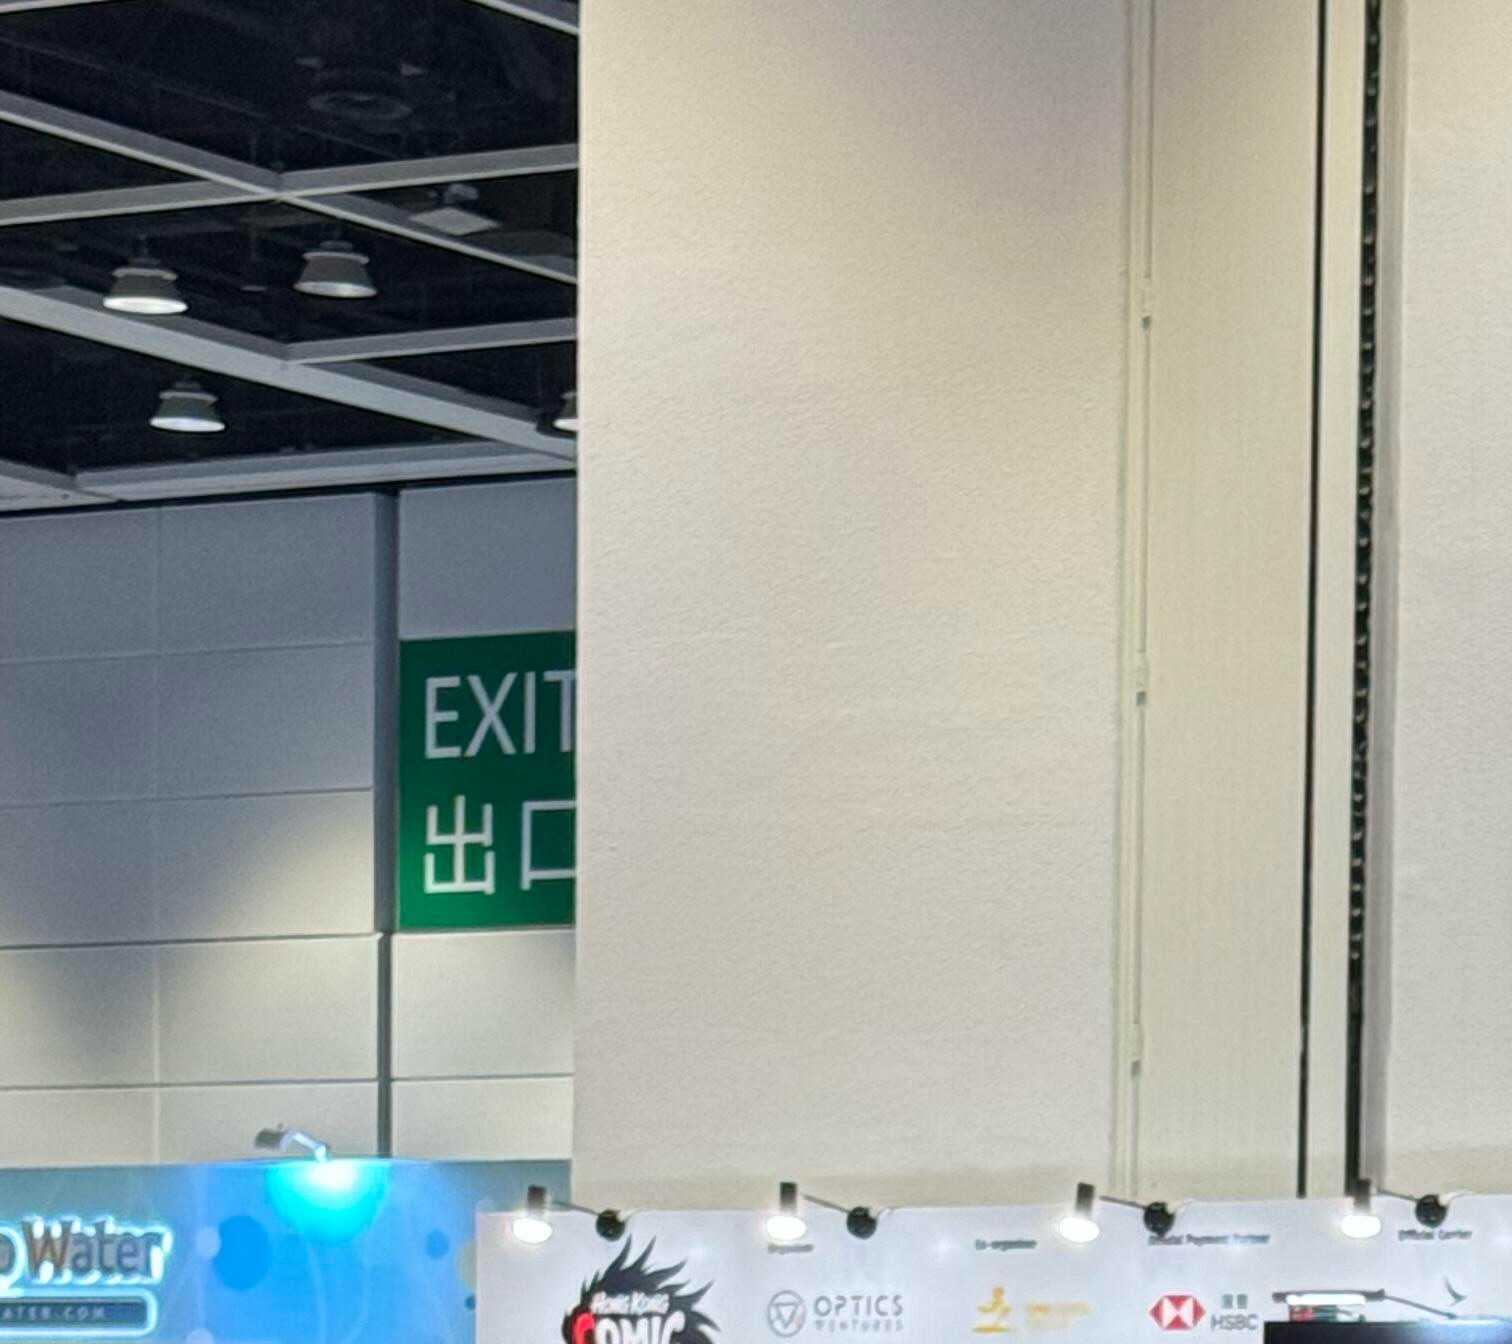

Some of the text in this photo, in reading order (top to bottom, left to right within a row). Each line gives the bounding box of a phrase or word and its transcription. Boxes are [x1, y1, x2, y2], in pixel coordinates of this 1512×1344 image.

[425, 670, 576, 759] EXIT
[424, 795, 576, 894] 出口
[814, 1295, 903, 1317] OPTICS
[1211, 1314, 1258, 1330] HSBC
